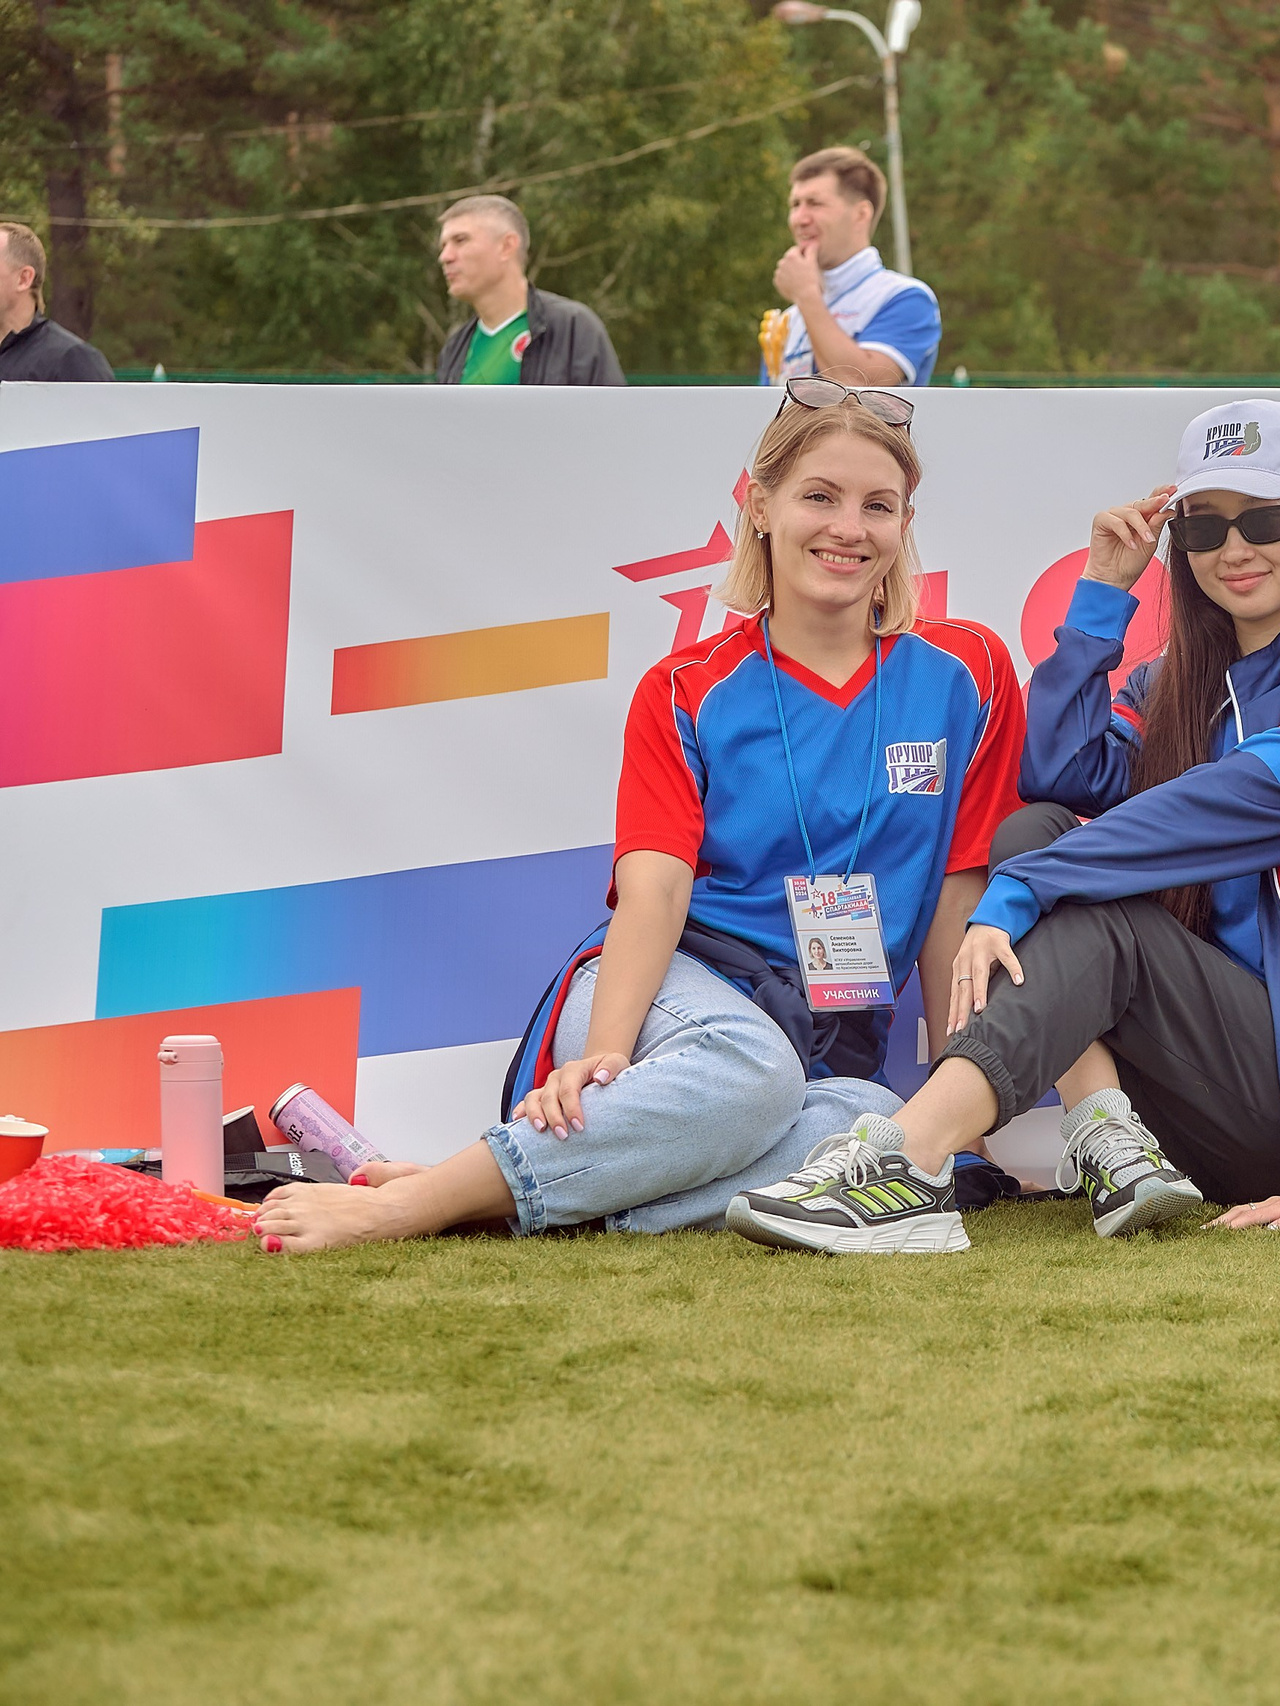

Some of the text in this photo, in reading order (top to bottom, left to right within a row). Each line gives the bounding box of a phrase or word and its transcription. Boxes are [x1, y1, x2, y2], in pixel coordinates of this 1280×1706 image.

[1206, 422, 1242, 442] КРУДОР
[887, 744, 933, 764] КРУДОР
[820, 891, 836, 907] 18
[825, 899, 869, 914] СПАРТАКИАДА
[822, 988, 880, 1000] УЧАСТНИК
